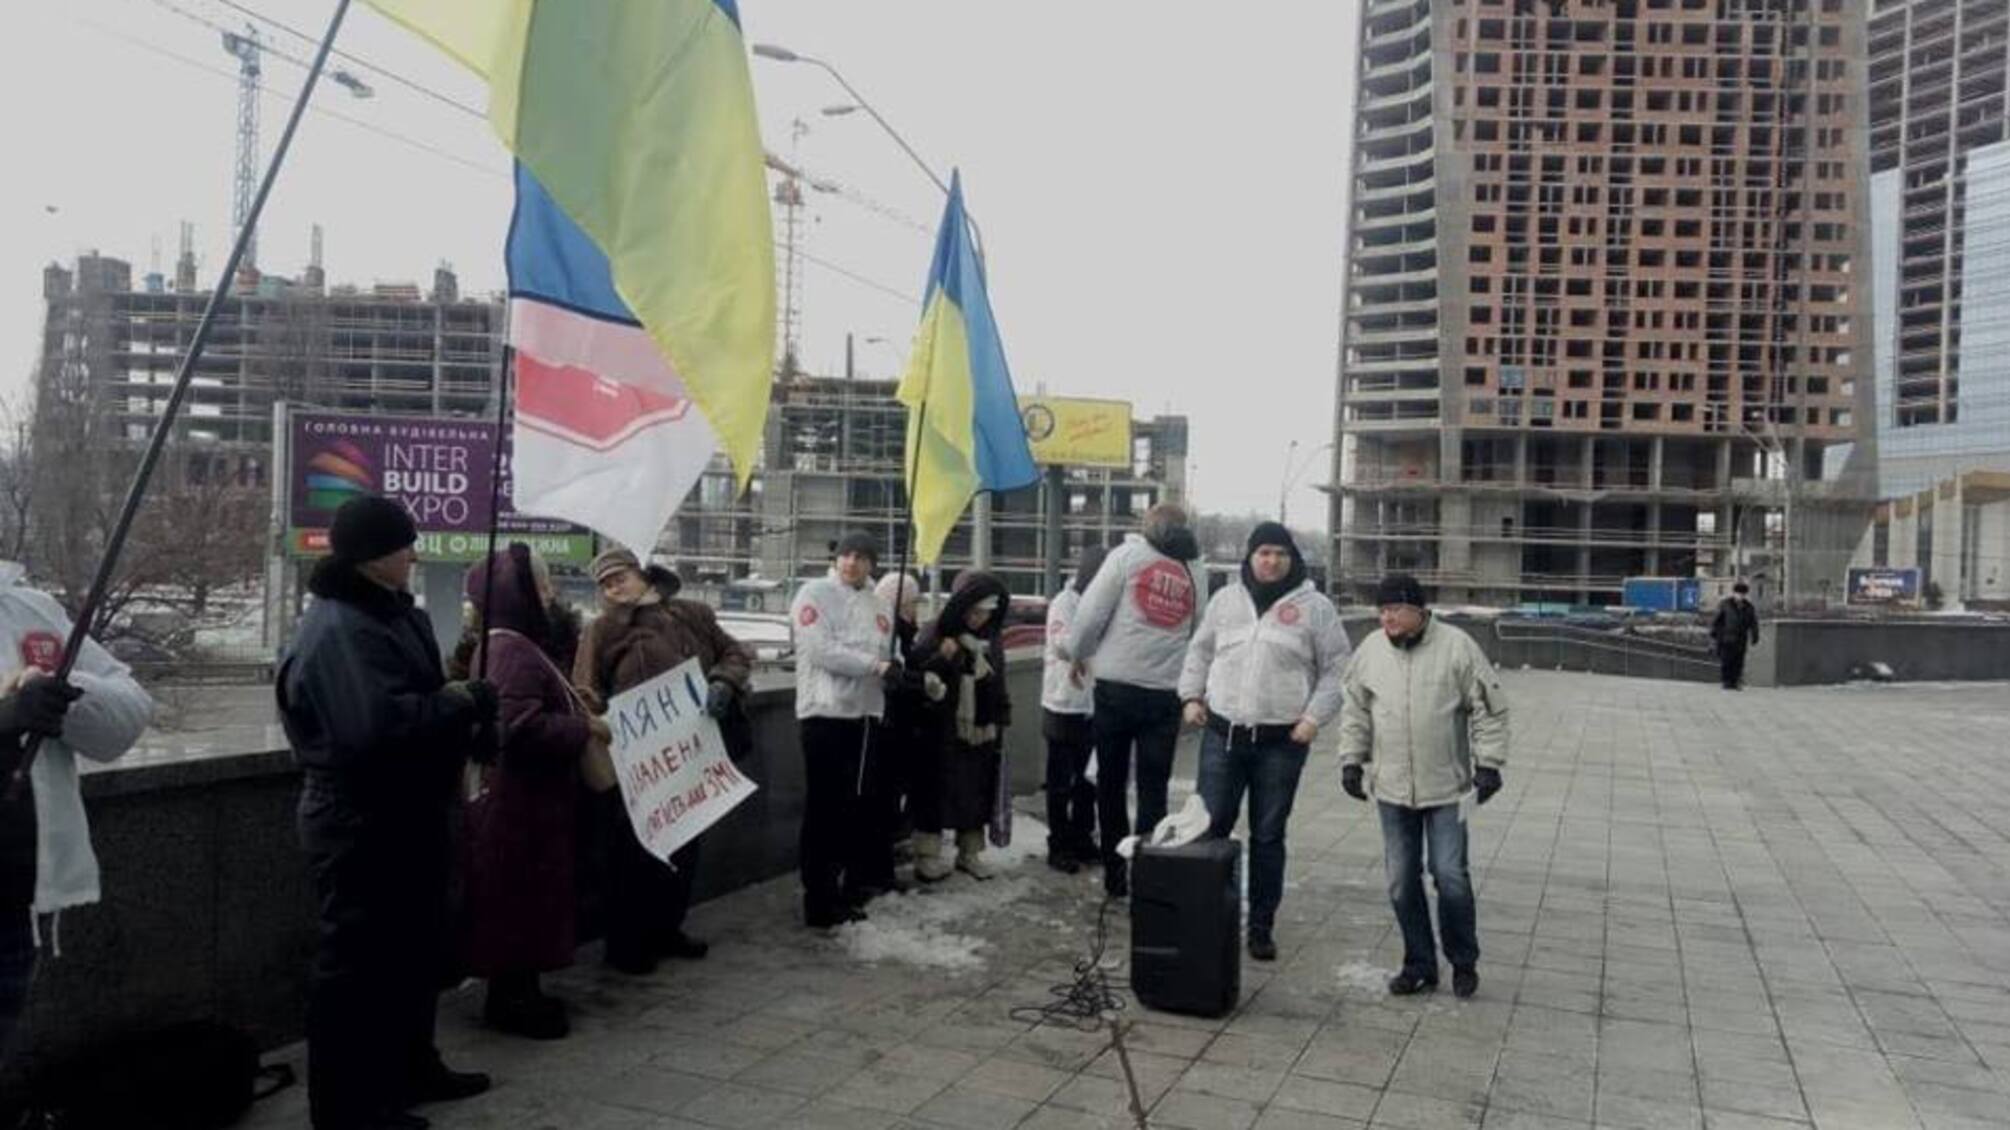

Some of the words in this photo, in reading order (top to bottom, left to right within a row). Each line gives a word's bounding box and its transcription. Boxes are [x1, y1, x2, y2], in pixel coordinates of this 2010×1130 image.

[304, 422, 382, 436] ГОЛОВНА
[389, 426, 489, 440] БУДІВЕЛЬНА
[384, 442, 468, 472] INTER
[384, 470, 469, 495] BUILD
[382, 493, 469, 525] XPO
